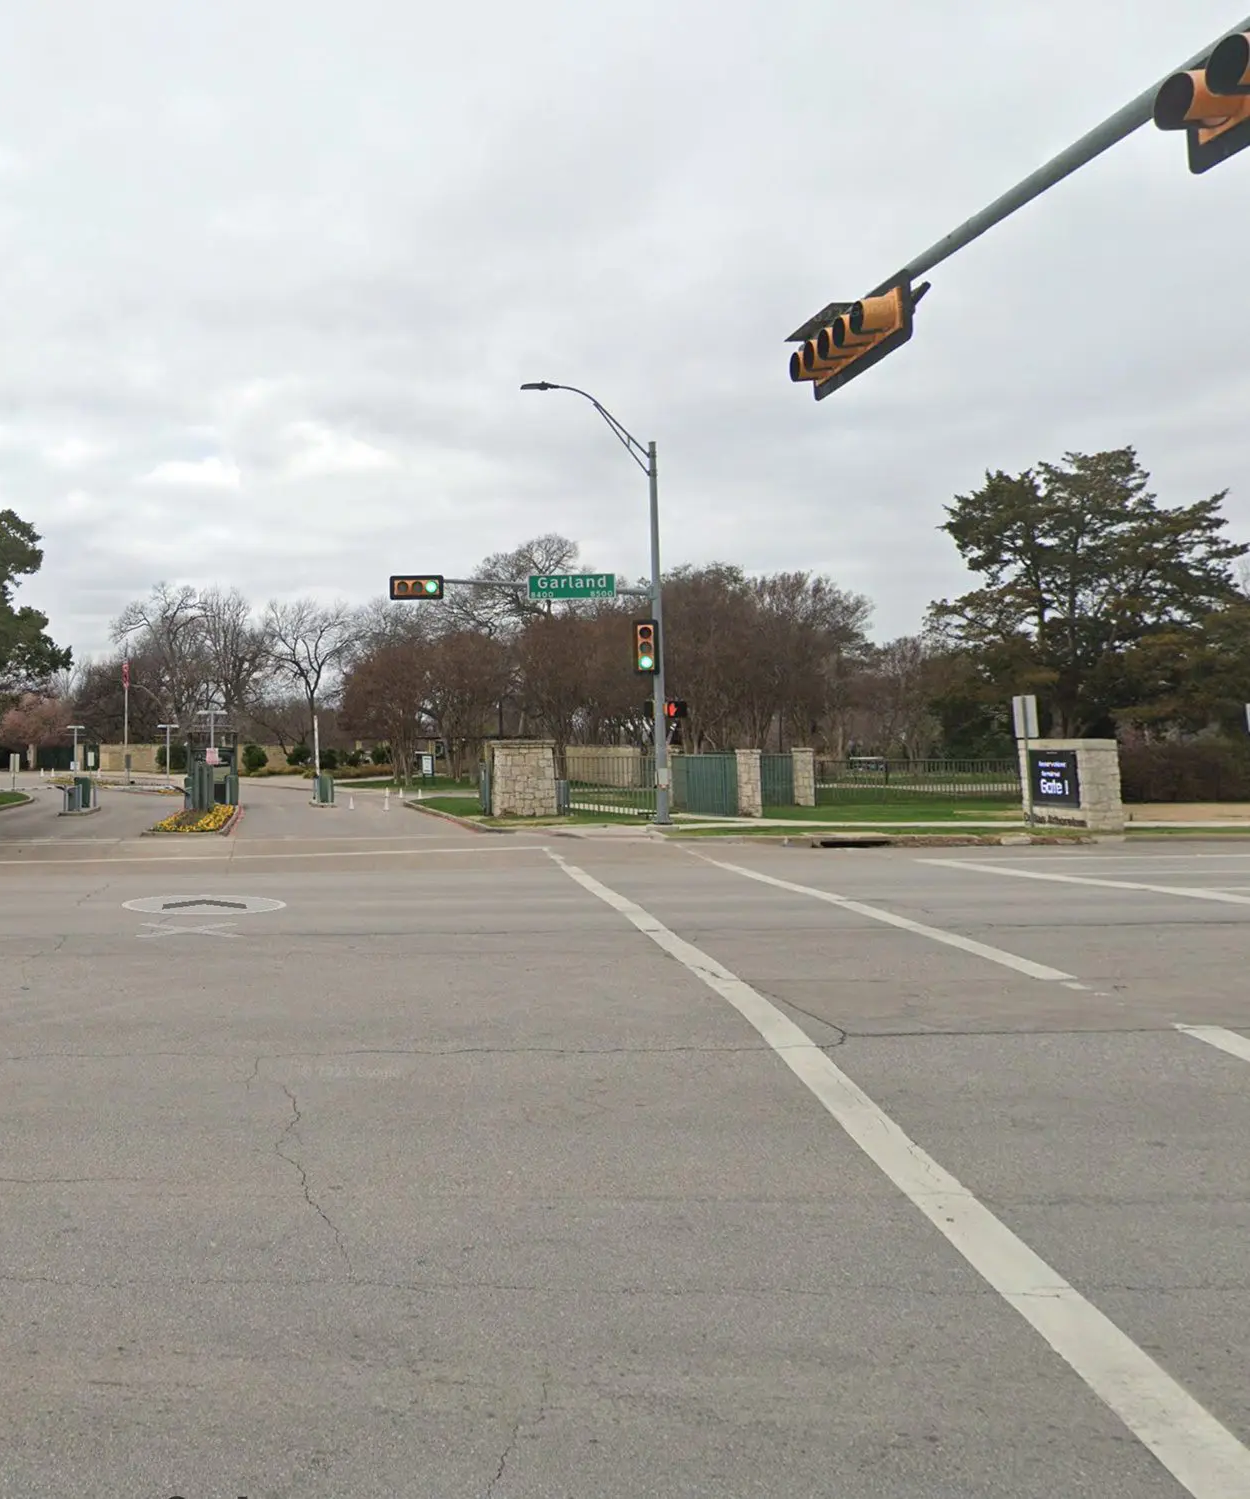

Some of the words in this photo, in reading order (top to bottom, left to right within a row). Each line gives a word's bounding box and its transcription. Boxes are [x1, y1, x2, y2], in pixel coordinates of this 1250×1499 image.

[537, 576, 606, 589] Garland
[590, 590, 613, 598] 8500
[1040, 778, 1063, 795] Gate
